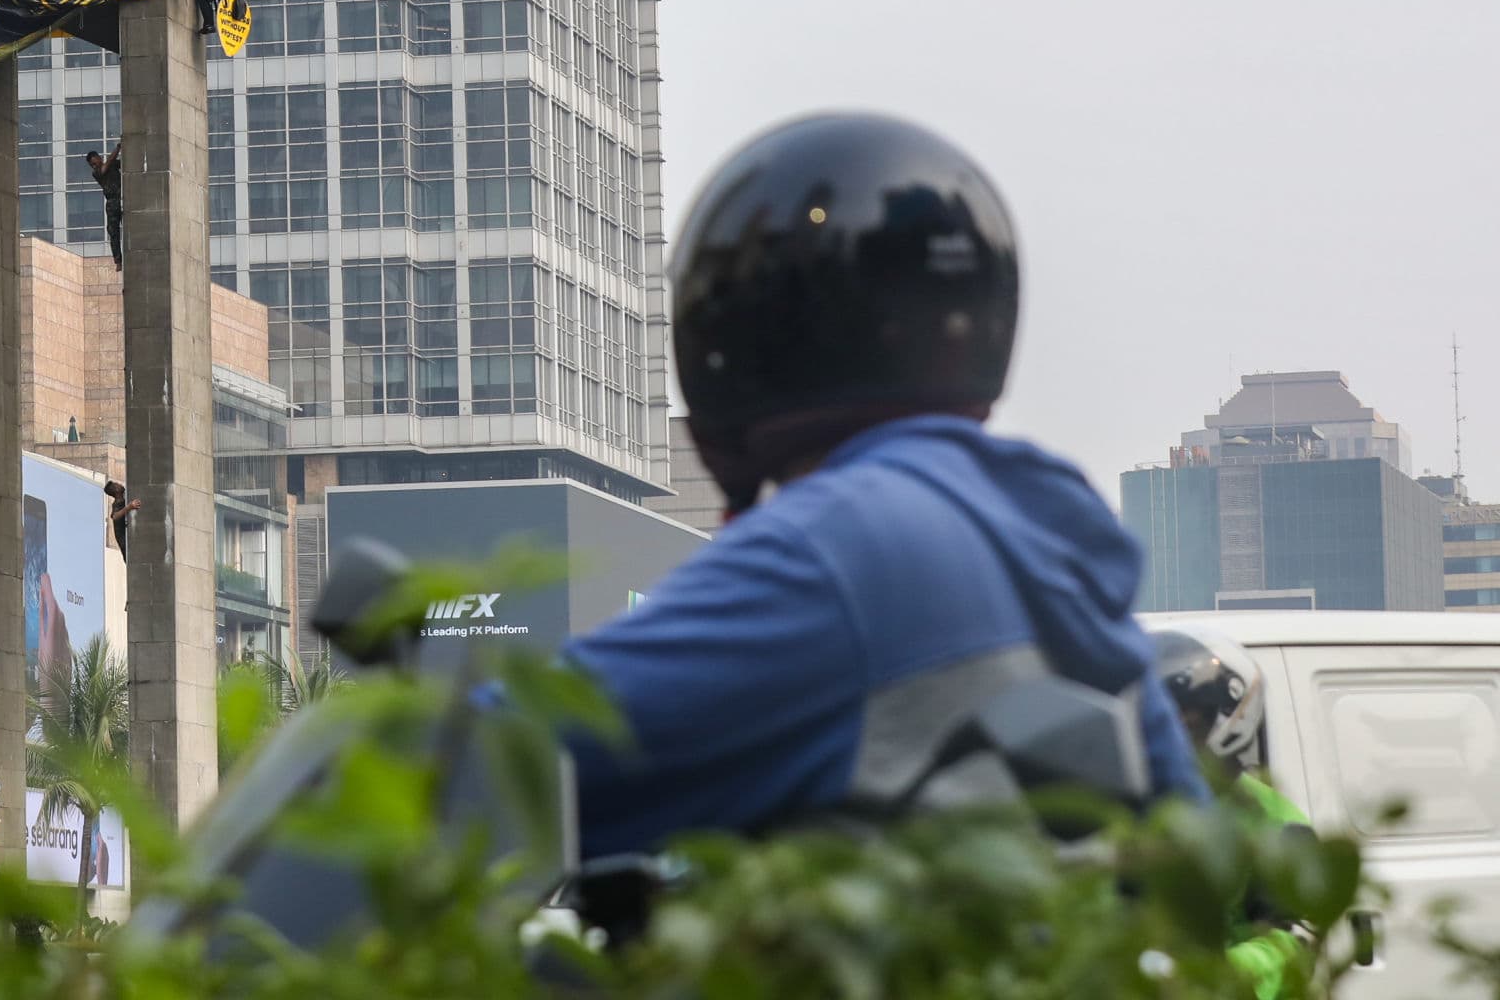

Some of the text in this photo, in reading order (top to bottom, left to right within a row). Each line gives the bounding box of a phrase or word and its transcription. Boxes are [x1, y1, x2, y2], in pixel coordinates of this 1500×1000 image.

[427, 626, 467, 637] Leading
[470, 625, 482, 635] FX
[484, 624, 529, 635] Platform
